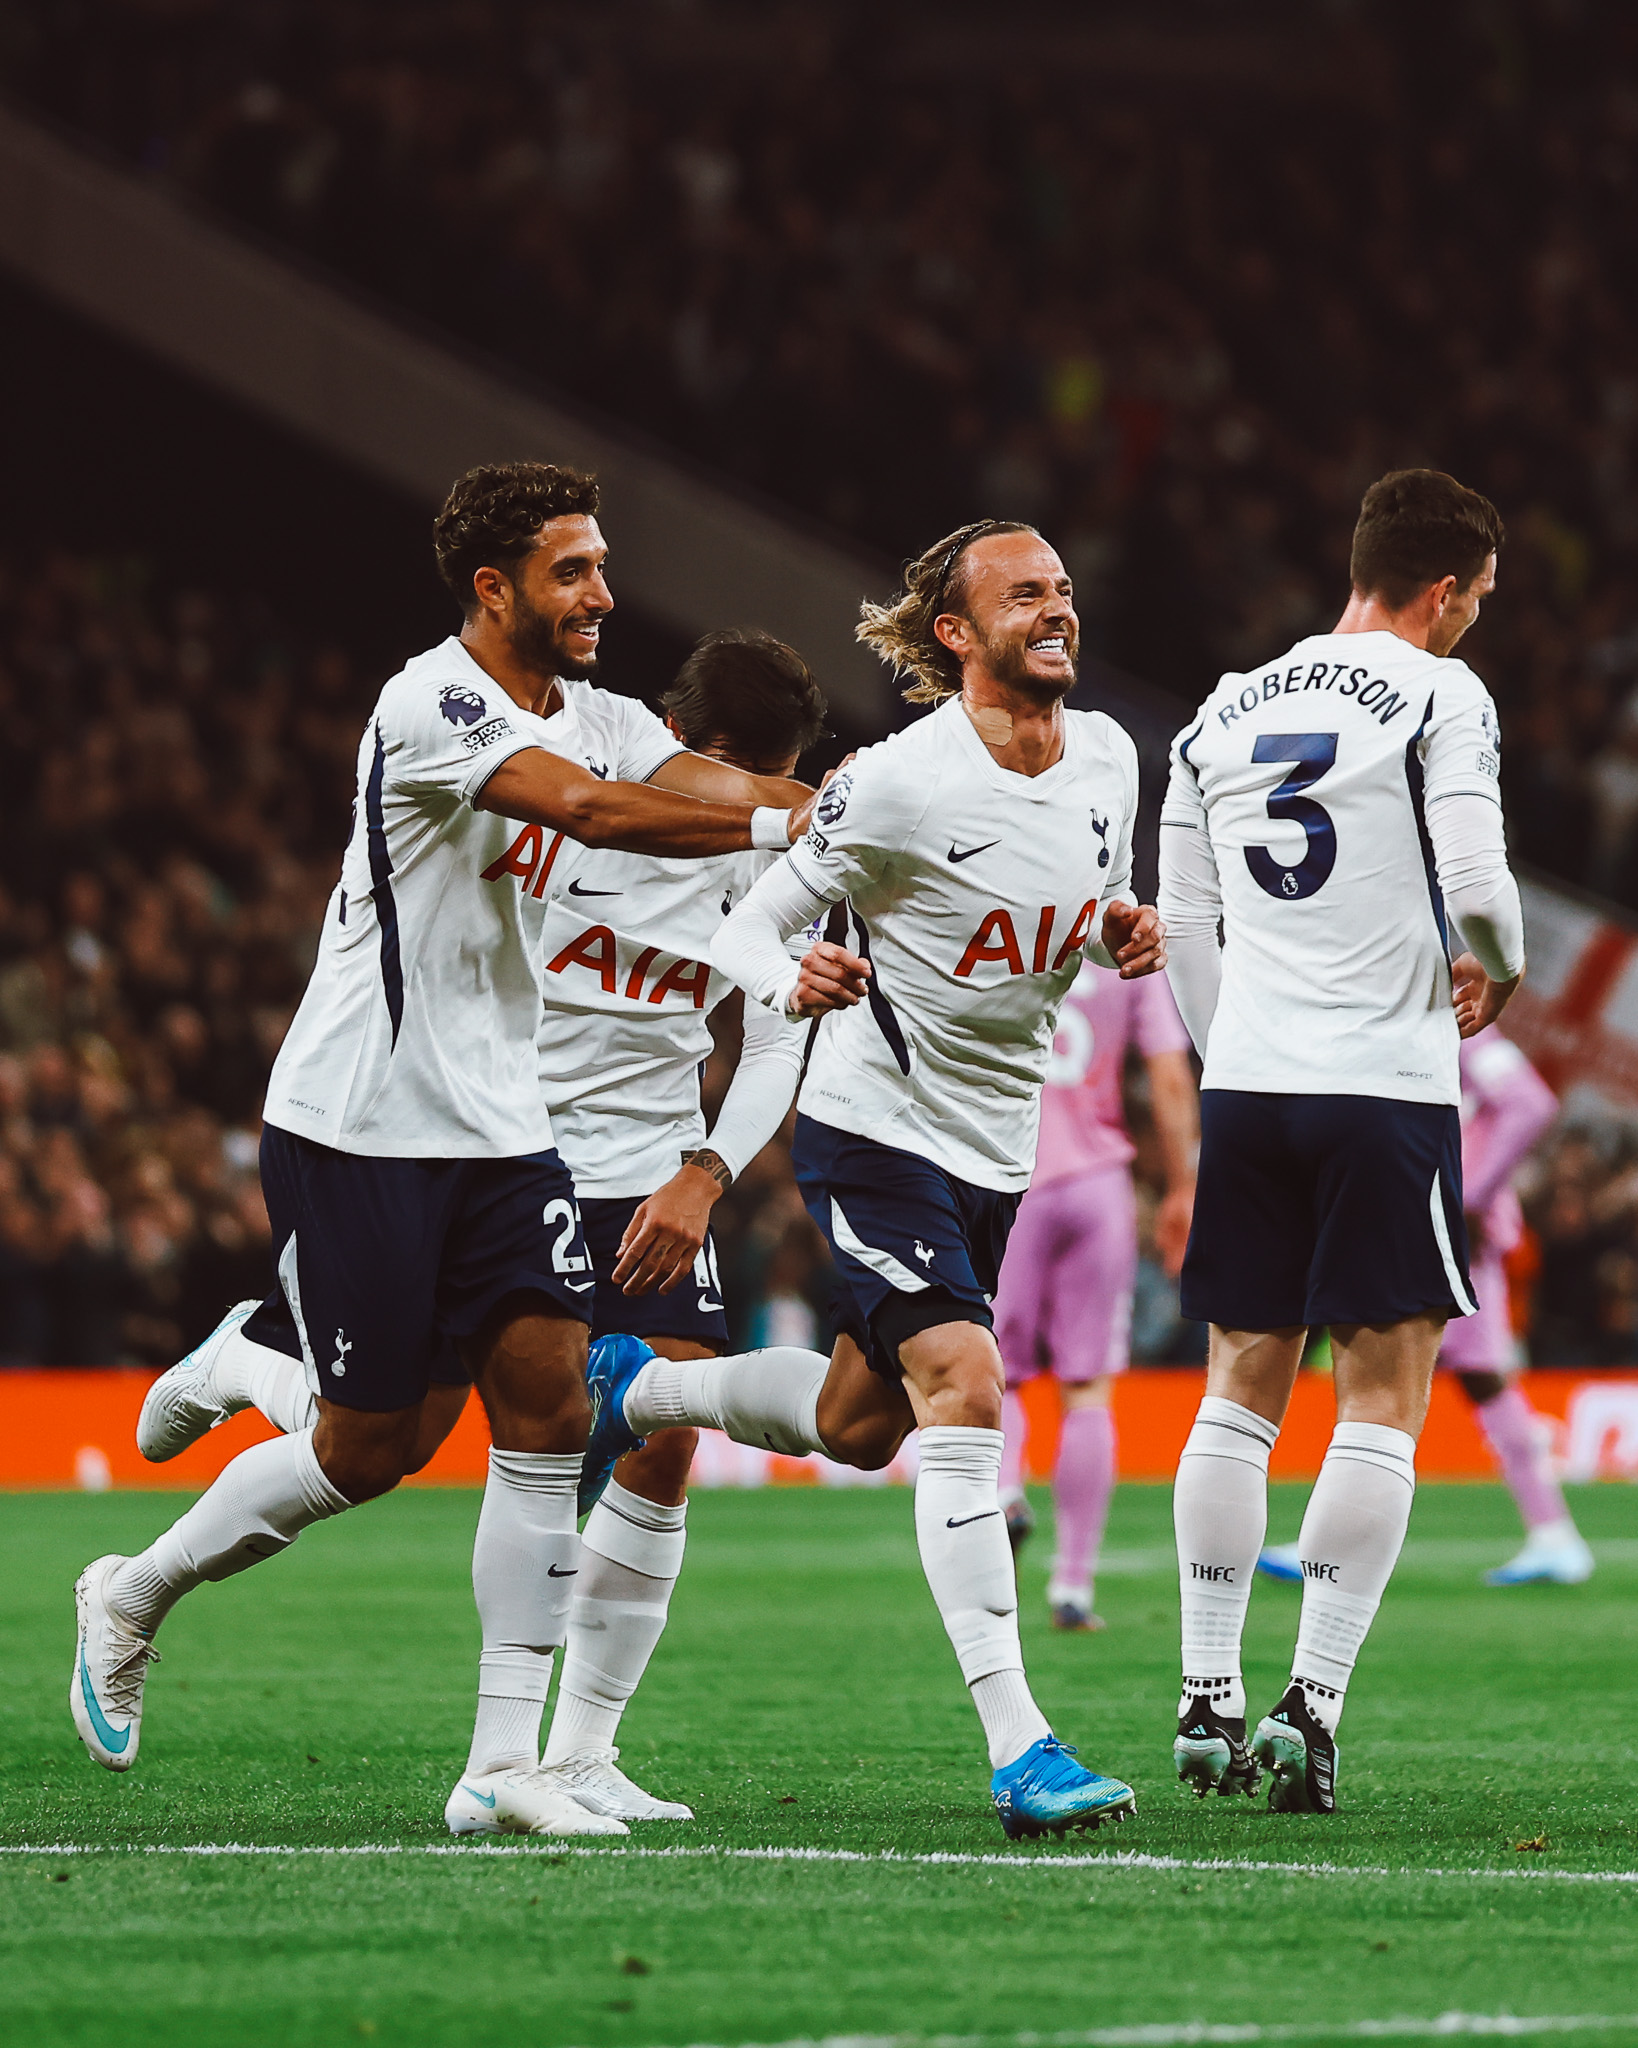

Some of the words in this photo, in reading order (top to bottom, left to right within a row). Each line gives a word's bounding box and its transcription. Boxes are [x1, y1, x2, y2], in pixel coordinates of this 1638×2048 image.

[1218, 662, 1408, 730] ROBERTSON
[461, 733, 480, 750] No
[478, 719, 509, 738] room
[1244, 732, 1340, 901] 3
[545, 924, 711, 1009] AIA
[953, 899, 1097, 977] AIA
[287, 1097, 326, 1116] AERO-FIT
[543, 1198, 594, 1273] 2
[1190, 1562, 1236, 1583] THFC
[1300, 1560, 1340, 1583] THFC
